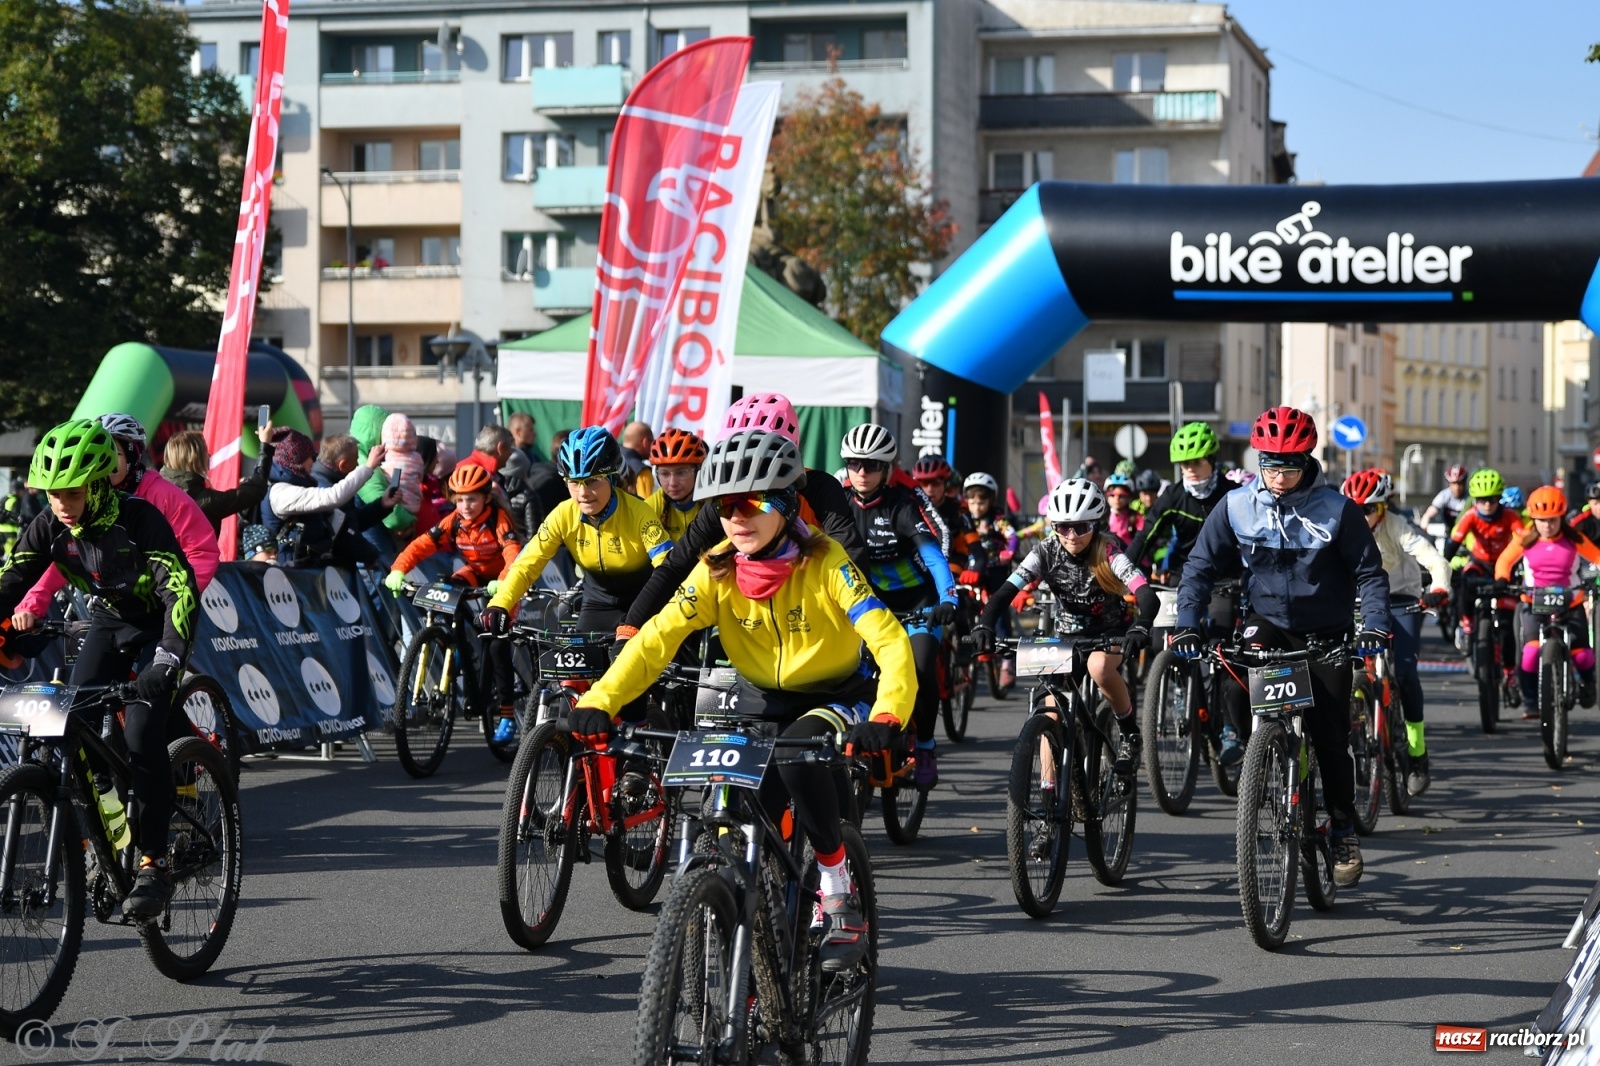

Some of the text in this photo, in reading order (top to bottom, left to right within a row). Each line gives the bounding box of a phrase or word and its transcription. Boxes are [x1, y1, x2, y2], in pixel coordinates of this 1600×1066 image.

[1170, 231, 1474, 284] bike atelier
[425, 589, 450, 602] 200
[210, 636, 260, 652] KOKOwear
[274, 631, 321, 647] KOKOwear
[554, 652, 587, 668] 132
[1263, 681, 1297, 701] 270
[13, 699, 51, 718] 109
[316, 715, 367, 735] KOKOwear
[256, 727, 301, 744] KOKOwear
[689, 748, 741, 767] 110
[231, 851, 241, 893] RABBIT
